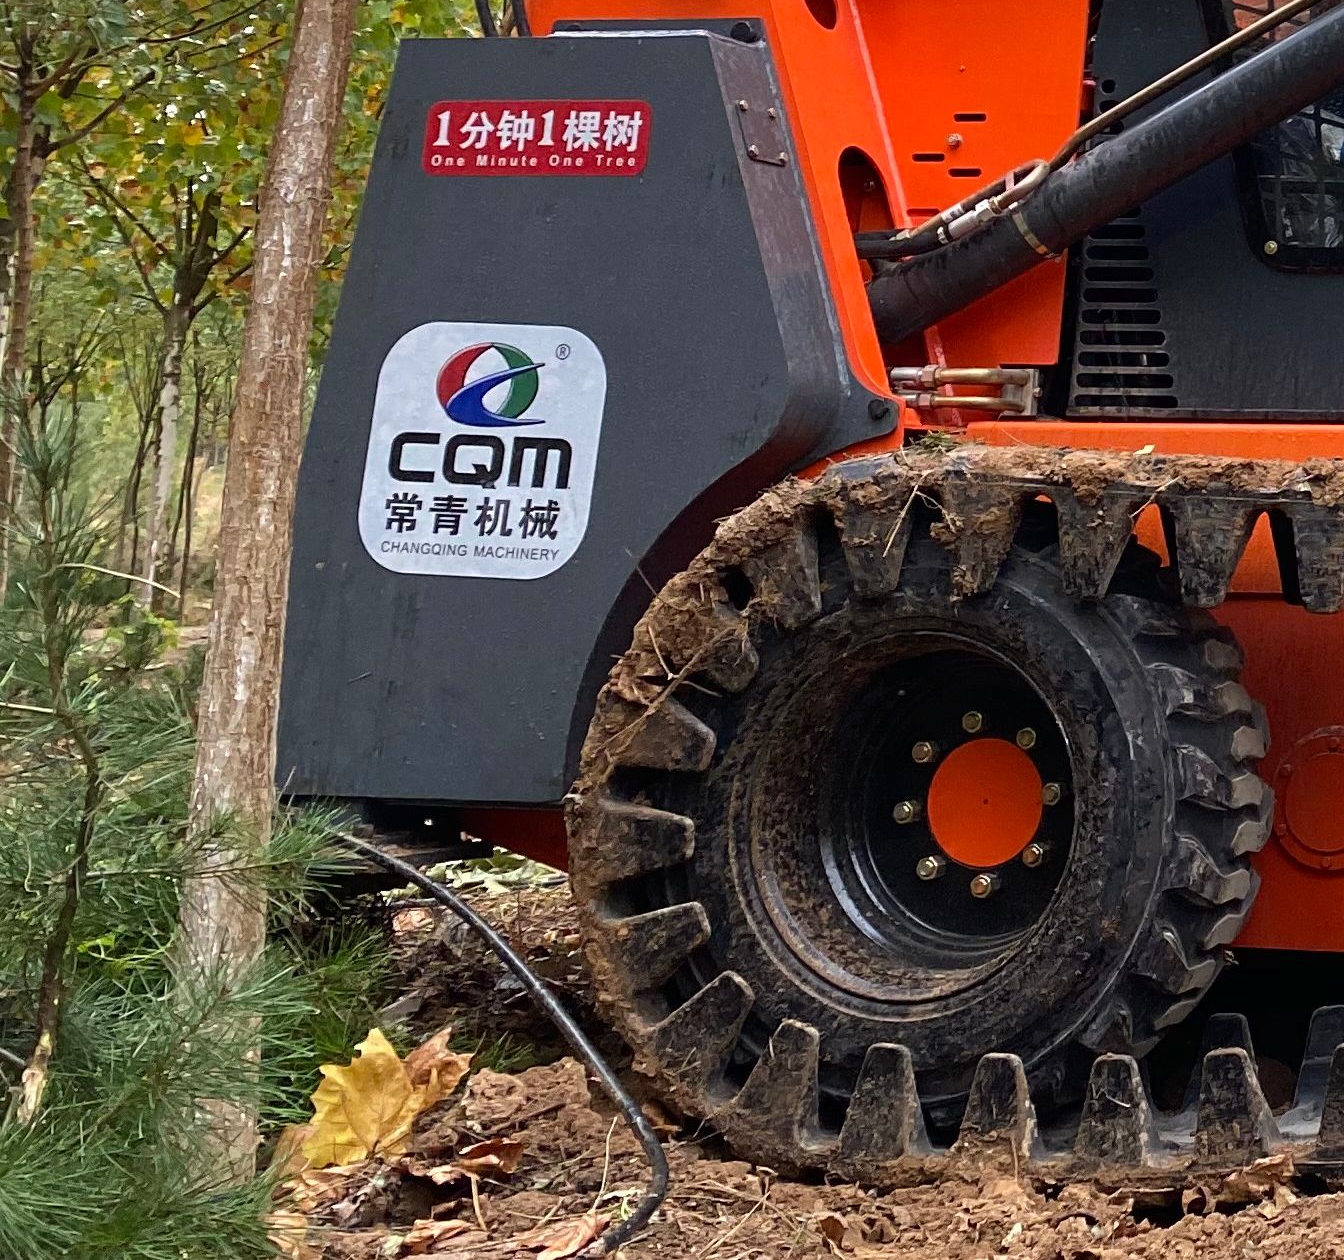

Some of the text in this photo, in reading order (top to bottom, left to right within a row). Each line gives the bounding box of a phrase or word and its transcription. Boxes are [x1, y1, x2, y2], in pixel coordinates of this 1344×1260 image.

[432, 109, 643, 152] 1分钟1棵树
[431, 154, 636, 167] One Minute One Tree
[385, 493, 561, 540] 常青机械
[380, 540, 559, 561] CHANGQING MACHINERY
